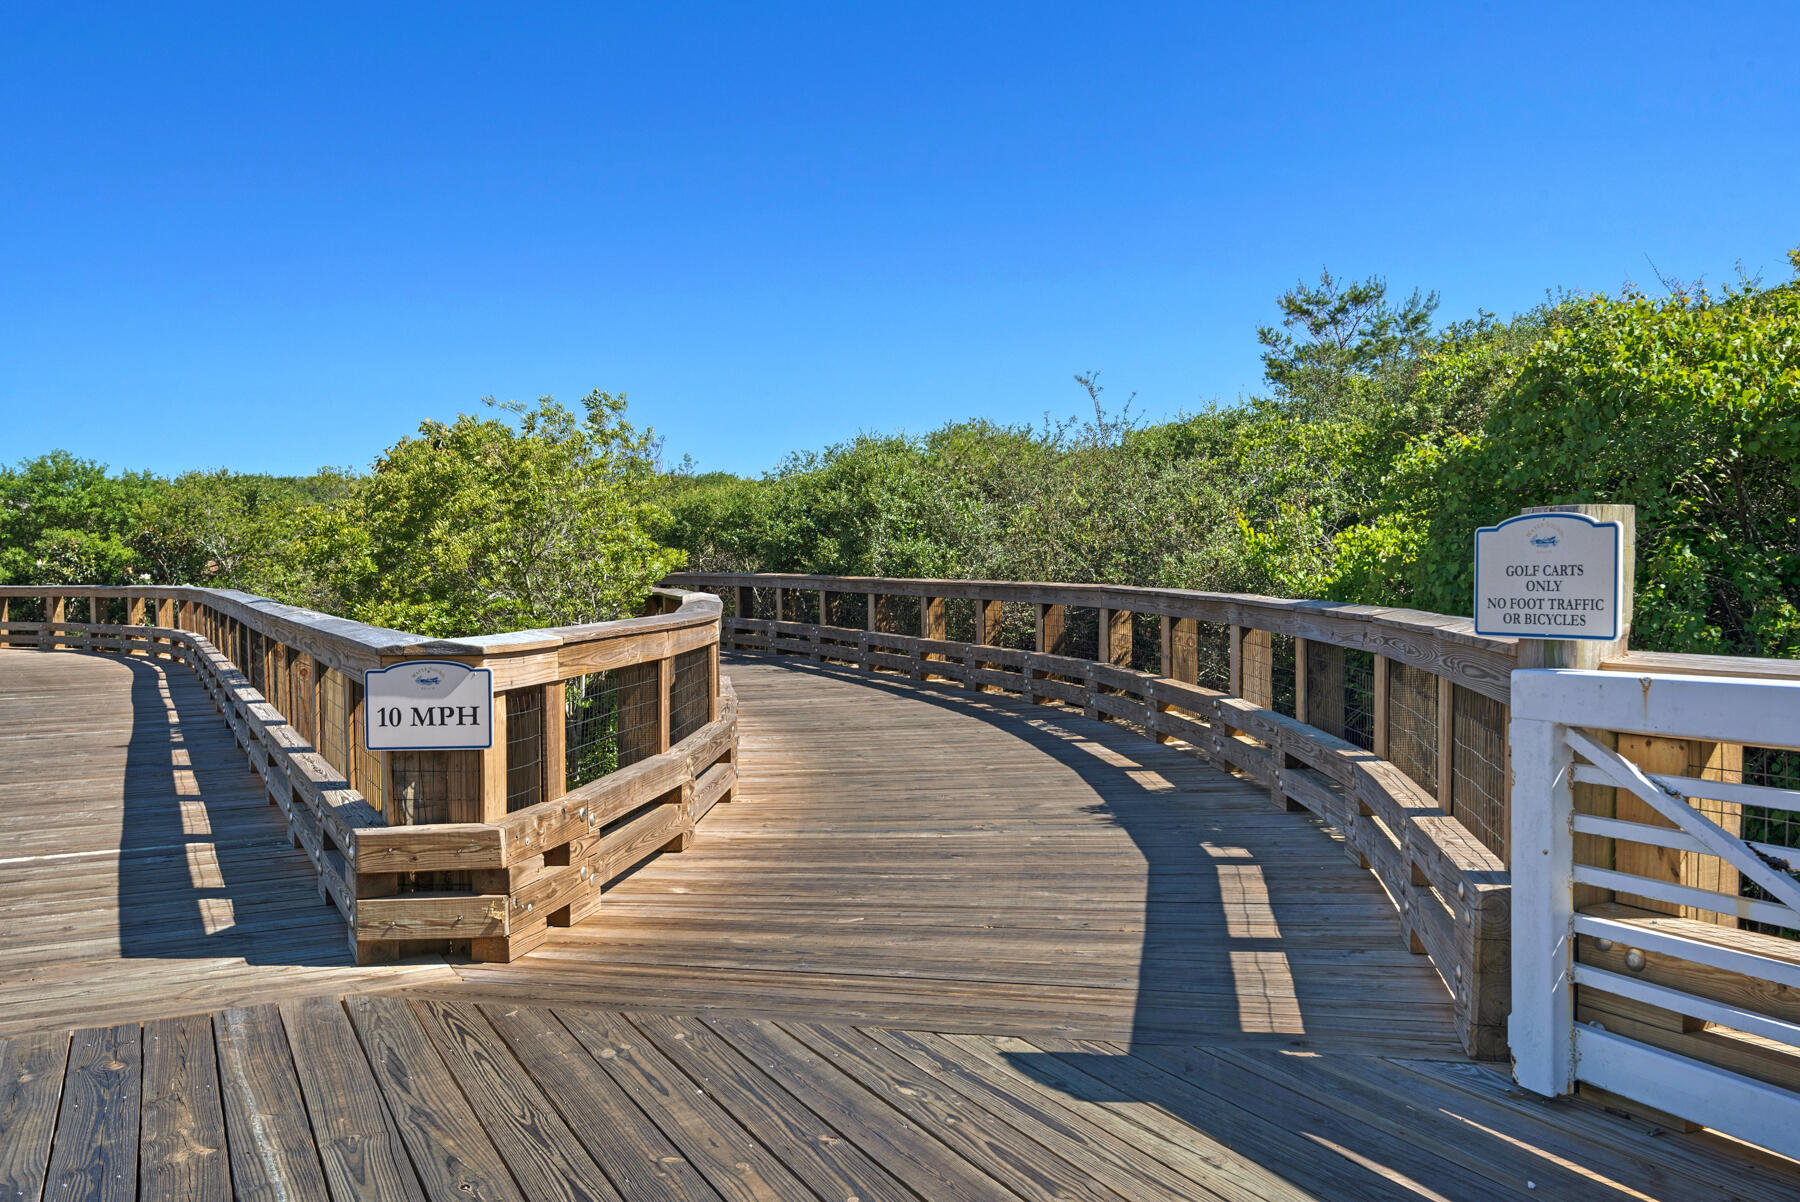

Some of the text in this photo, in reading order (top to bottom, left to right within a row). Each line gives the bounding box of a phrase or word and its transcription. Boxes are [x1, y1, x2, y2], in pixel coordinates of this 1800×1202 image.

[1505, 564, 1584, 577] GOLF CARTS
[1526, 580, 1563, 592] ONLY
[1487, 597, 1604, 611] NO FOOT TRAFFIC
[1503, 613, 1586, 626] OR BICYCLES
[377, 706, 480, 728] 10 MPH
